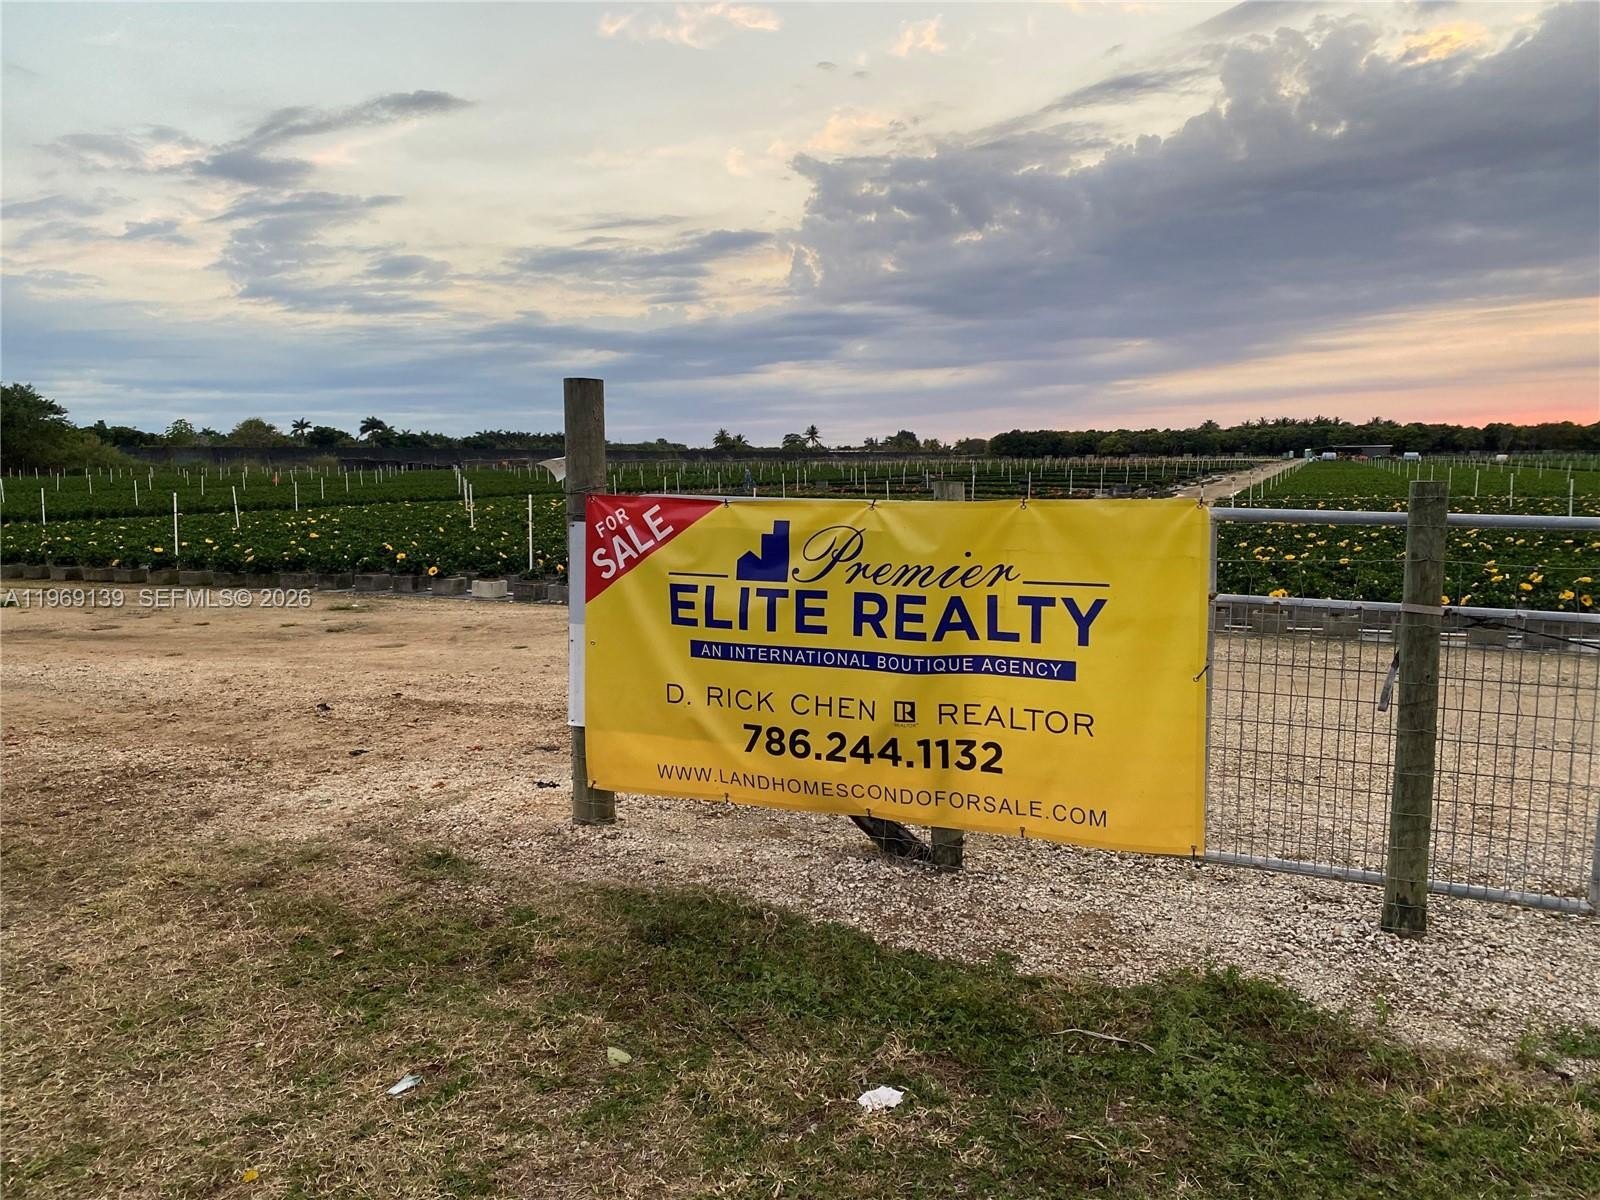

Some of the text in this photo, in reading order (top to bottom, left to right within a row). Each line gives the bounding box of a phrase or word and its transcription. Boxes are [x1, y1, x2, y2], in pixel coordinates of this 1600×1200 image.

[592, 503, 674, 580] SALE
[595, 507, 630, 538] FOR
[791, 525, 1021, 589] Premier
[669, 583, 1108, 647] ELITE REALTY
[701, 642, 1063, 678] AN INTERNATIONAL BOUTIQUE AGENCY
[666, 683, 691, 706] D.
[707, 686, 775, 713] RICK
[790, 694, 876, 722] CHEN
[938, 703, 1094, 737] REALTOR
[743, 723, 1004, 775] 786.244.1132
[657, 763, 1108, 828] WWW.LANDHOMESCONDOFORSALE.COM
